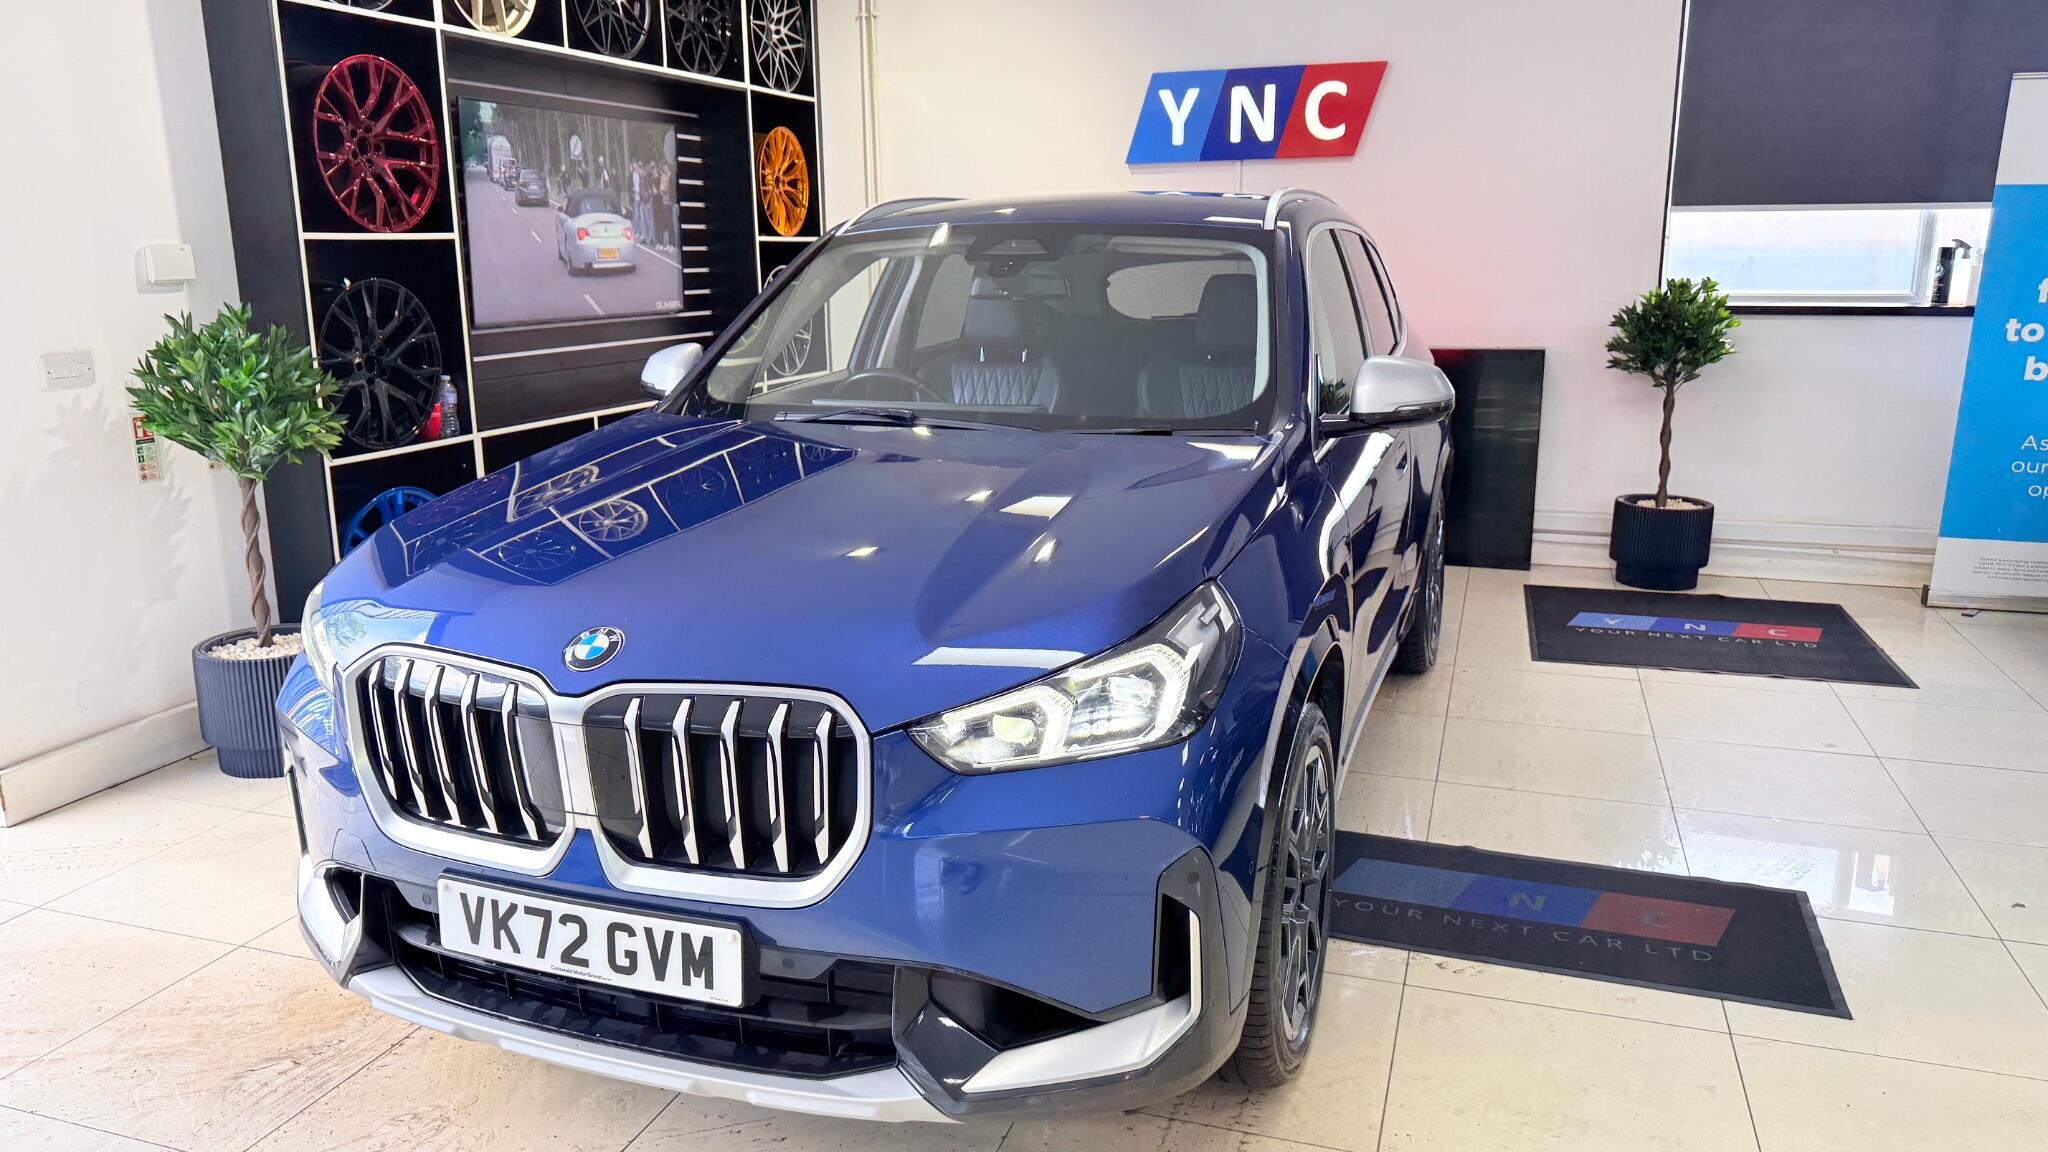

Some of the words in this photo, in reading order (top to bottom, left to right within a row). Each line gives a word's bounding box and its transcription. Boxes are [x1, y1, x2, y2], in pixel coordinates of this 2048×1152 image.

[1158, 80, 1348, 146] YNC
[2005, 318, 2045, 343] to
[579, 628, 620, 642] BMW
[1576, 627, 1636, 635] YOUR
[1647, 631, 1705, 640] NEXT
[1718, 636, 1762, 645] CAR
[1775, 640, 1818, 649] LTD
[459, 892, 589, 968] VK72
[606, 921, 714, 990] GVM
[1333, 899, 1423, 920] YOUR
[1443, 914, 1535, 935] NEXT
[1552, 931, 1624, 950] CAR
[1645, 943, 1713, 961] LTD
